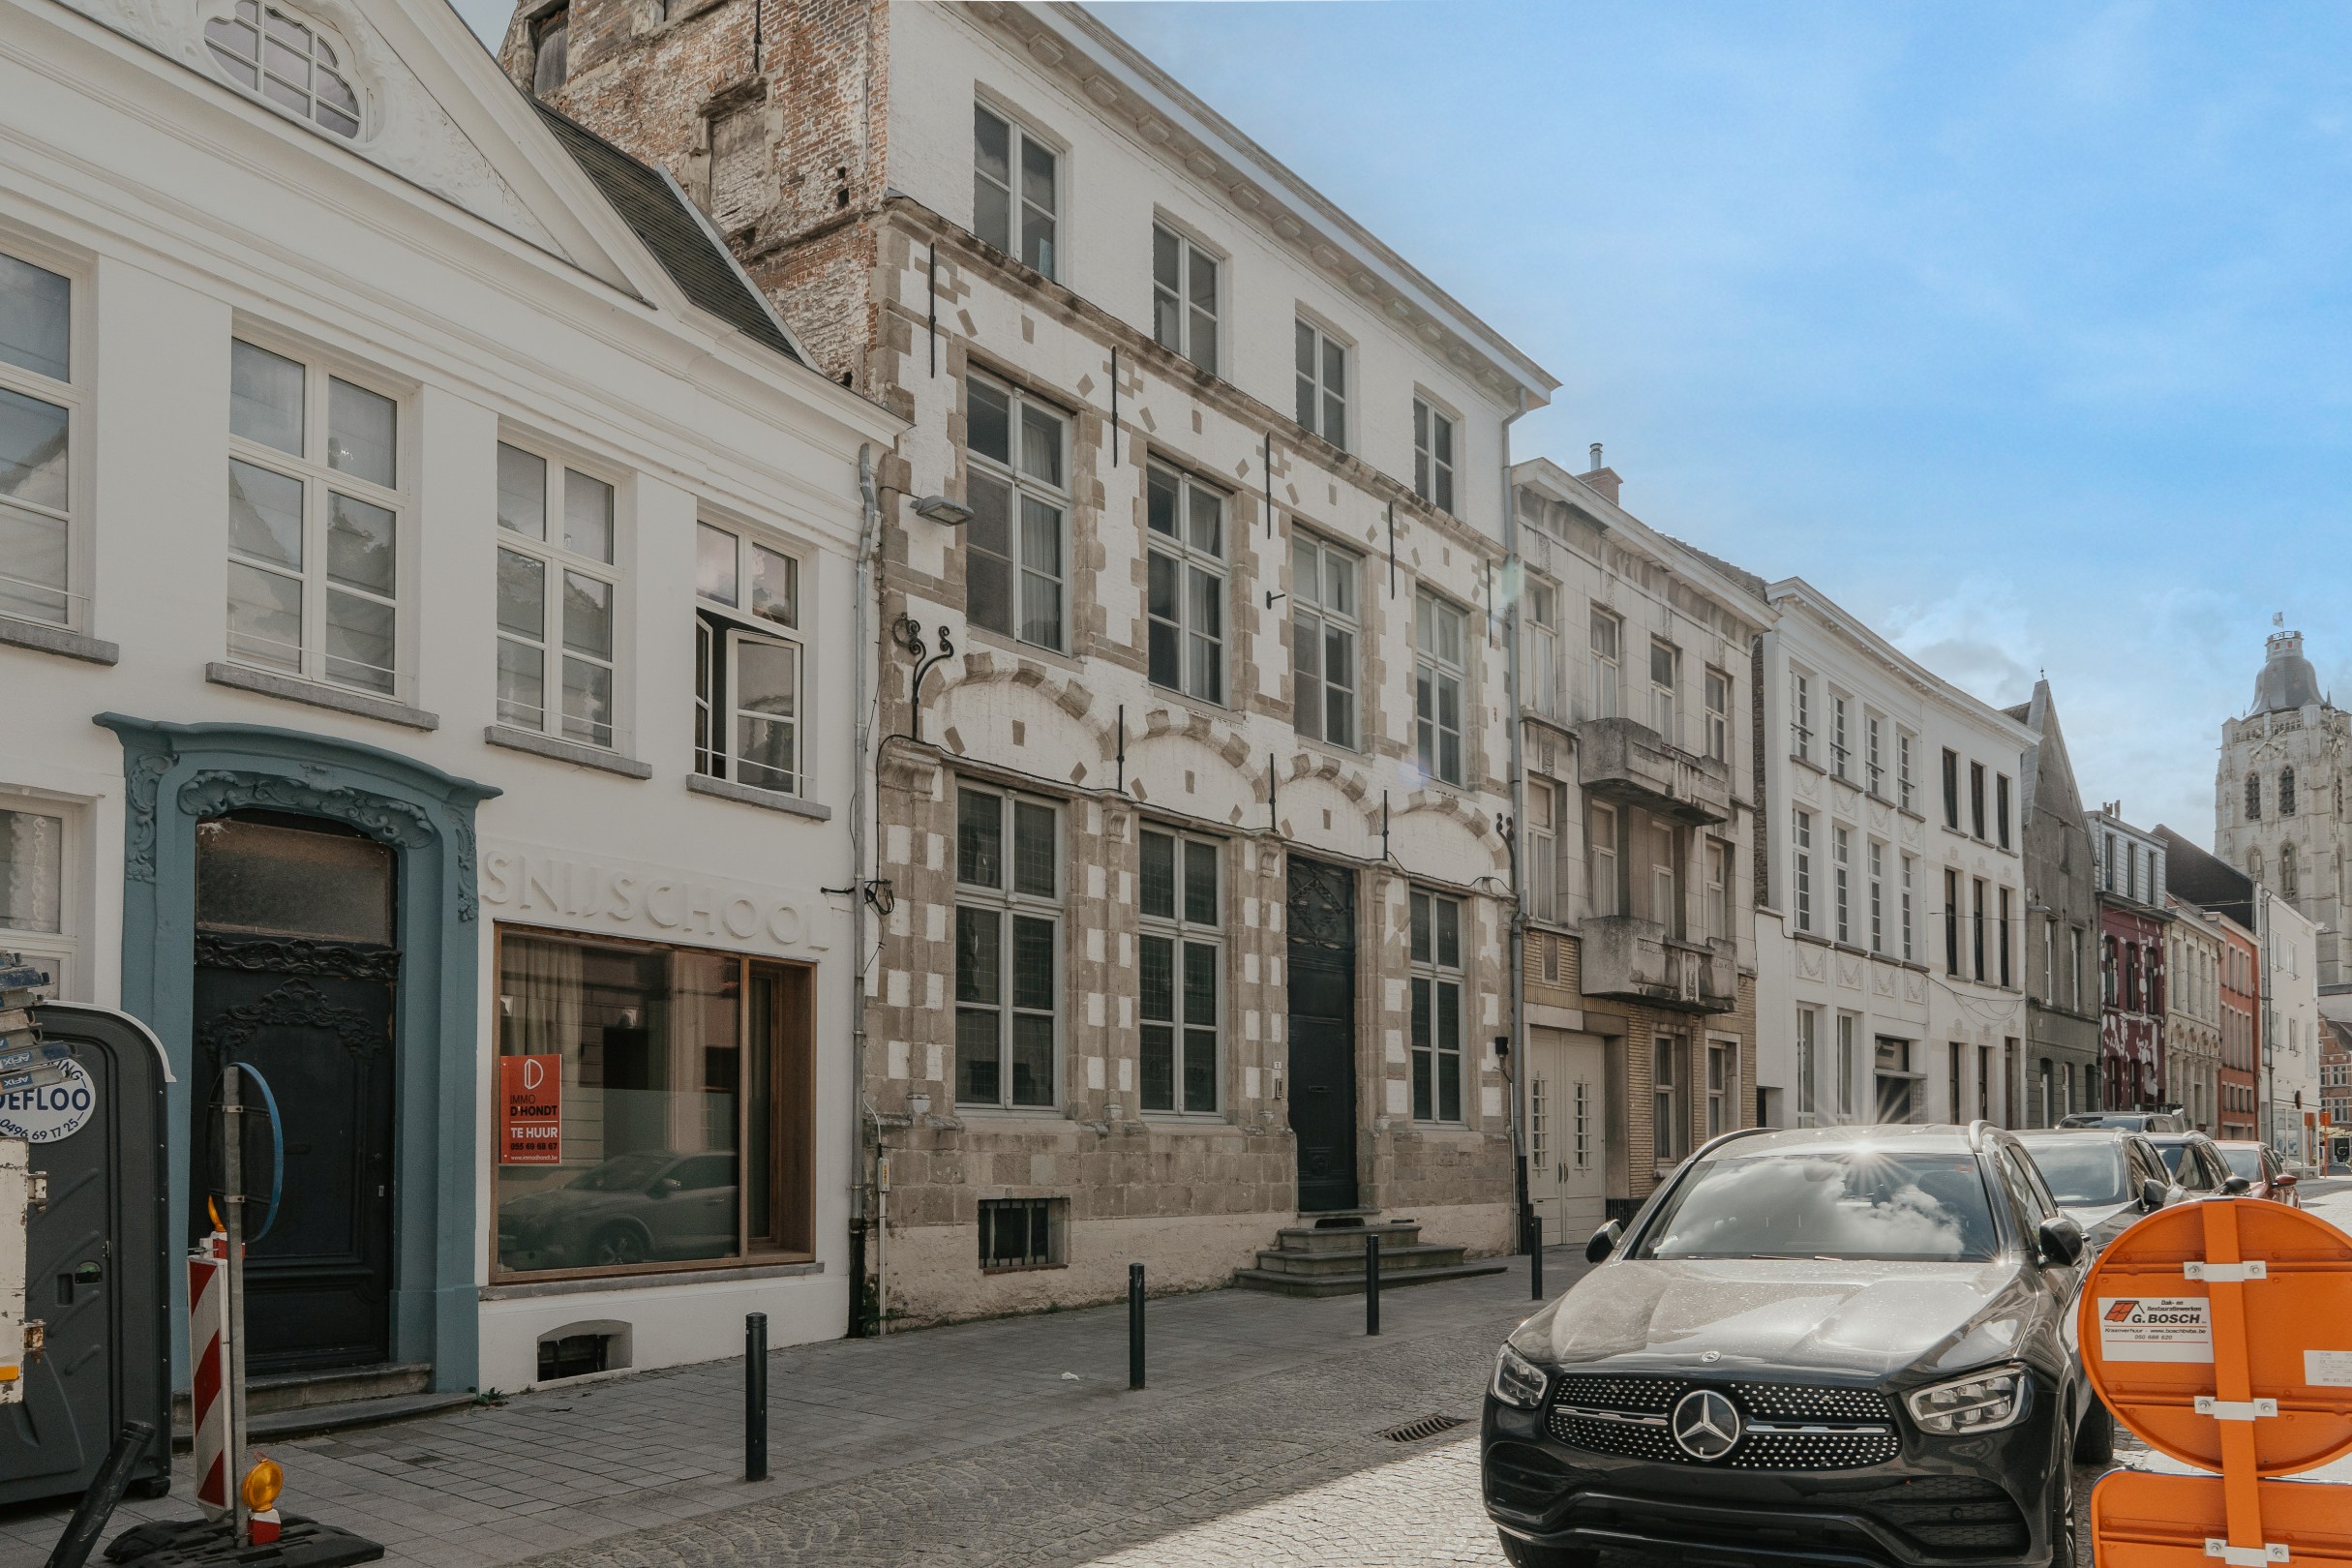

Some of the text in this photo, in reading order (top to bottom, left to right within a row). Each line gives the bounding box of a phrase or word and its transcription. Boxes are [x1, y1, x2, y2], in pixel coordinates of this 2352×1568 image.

[4, 1075, 29, 1086] AFIX
[0, 1087, 91, 1111] EFLOO
[510, 1095, 536, 1104] IMMO
[510, 1105, 558, 1116] D'HONDT
[32, 1131, 47, 1140] 69
[50, 1127, 61, 1138] 17
[63, 1118, 78, 1132] 25
[510, 1127, 558, 1138] TE HUUR
[2131, 1313, 2200, 1324] G. BOSCH
